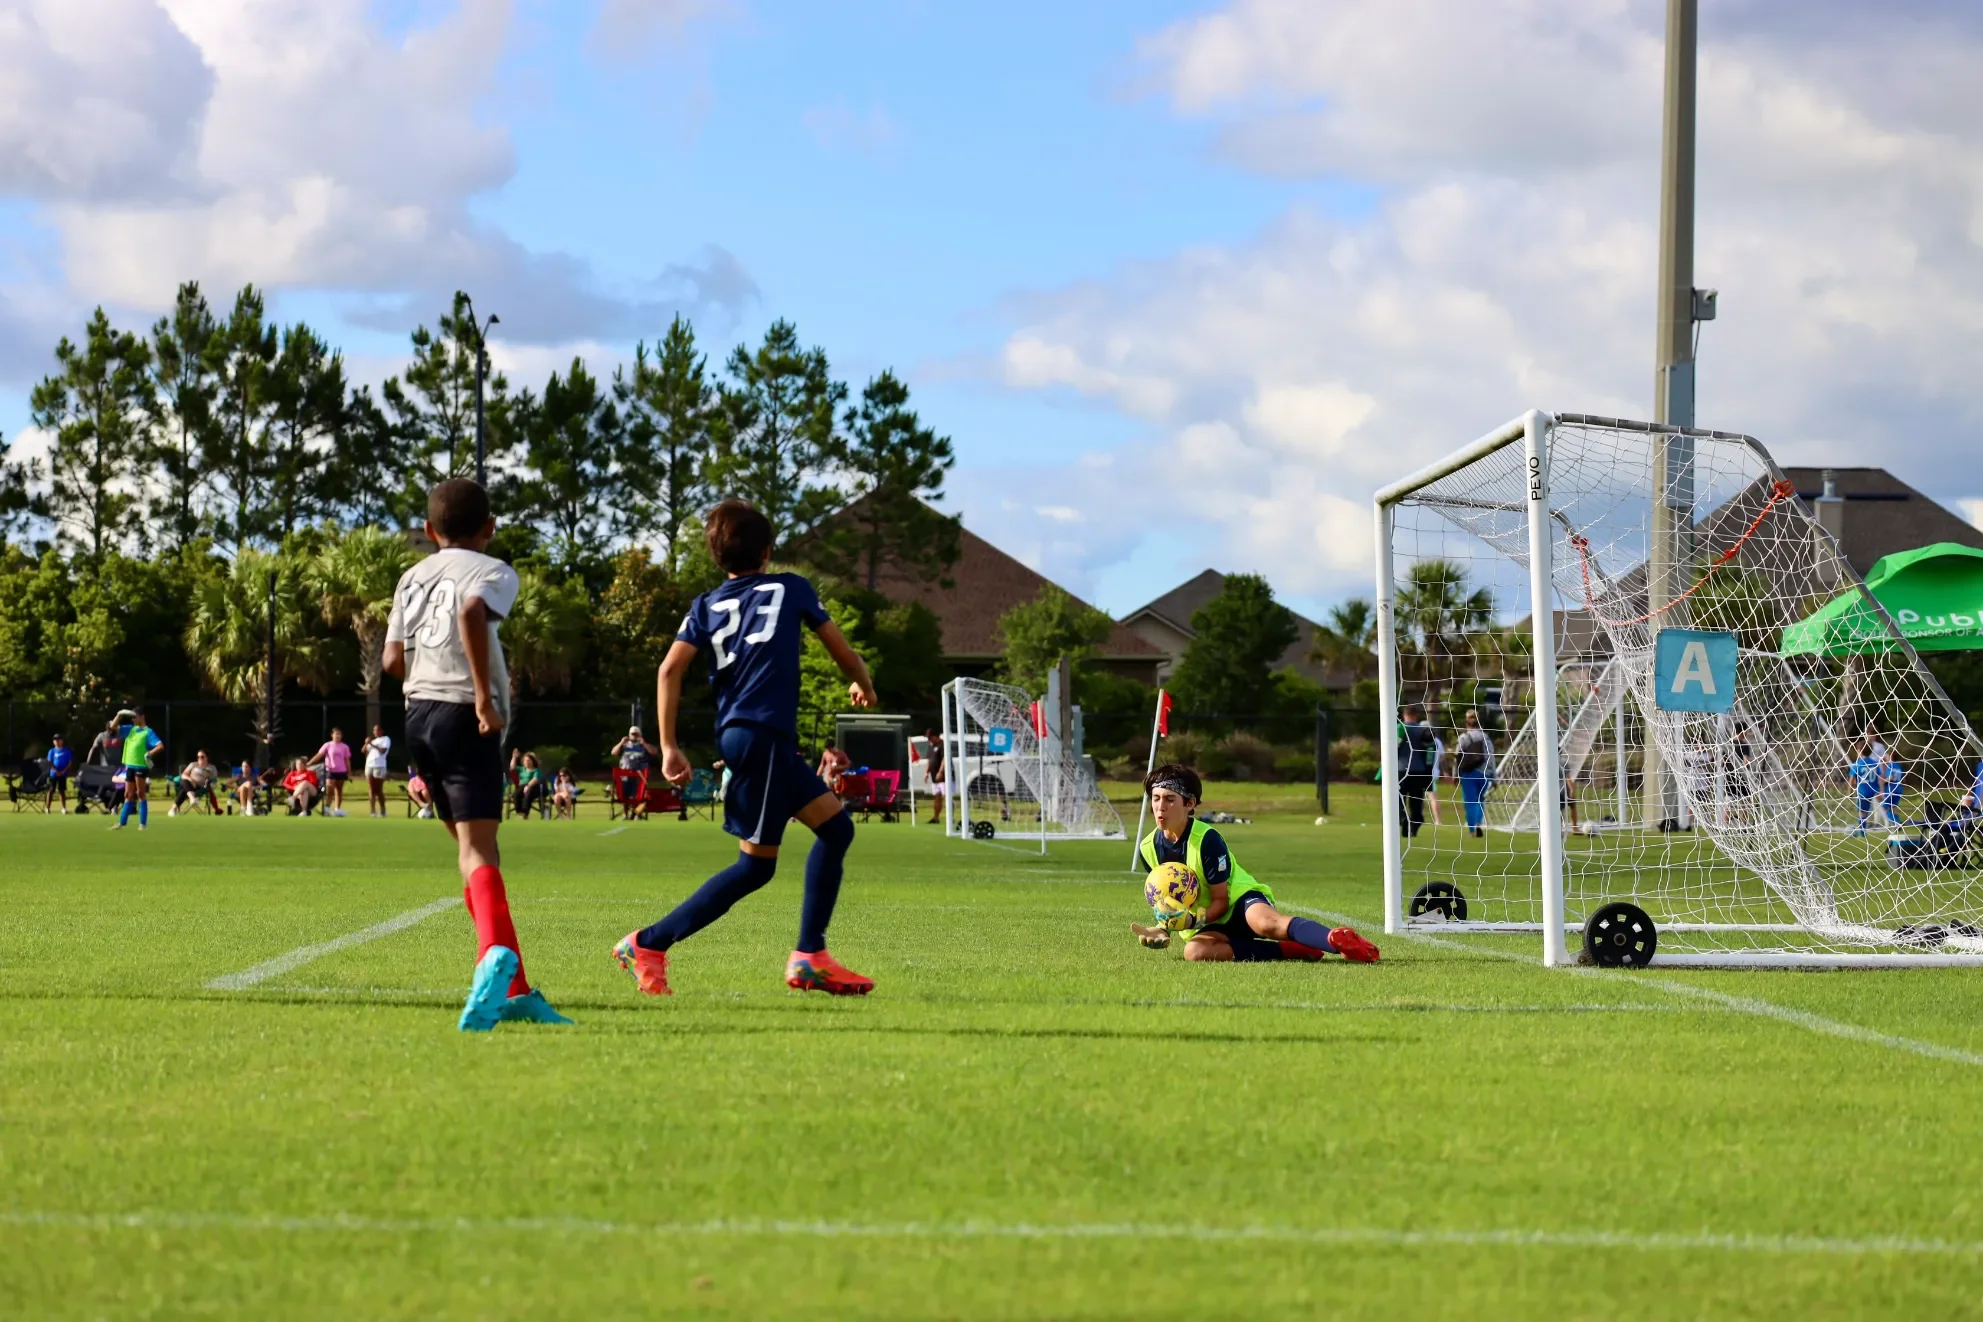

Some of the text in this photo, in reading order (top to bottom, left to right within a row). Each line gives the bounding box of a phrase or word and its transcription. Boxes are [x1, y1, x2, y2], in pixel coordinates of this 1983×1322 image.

[1529, 457, 1542, 500] PEVO
[710, 583, 785, 670] 23
[1897, 628, 1952, 638] PONSOR
[1955, 626, 1972, 637] OF
[1671, 641, 1716, 694] A
[994, 732, 1006, 746] B
